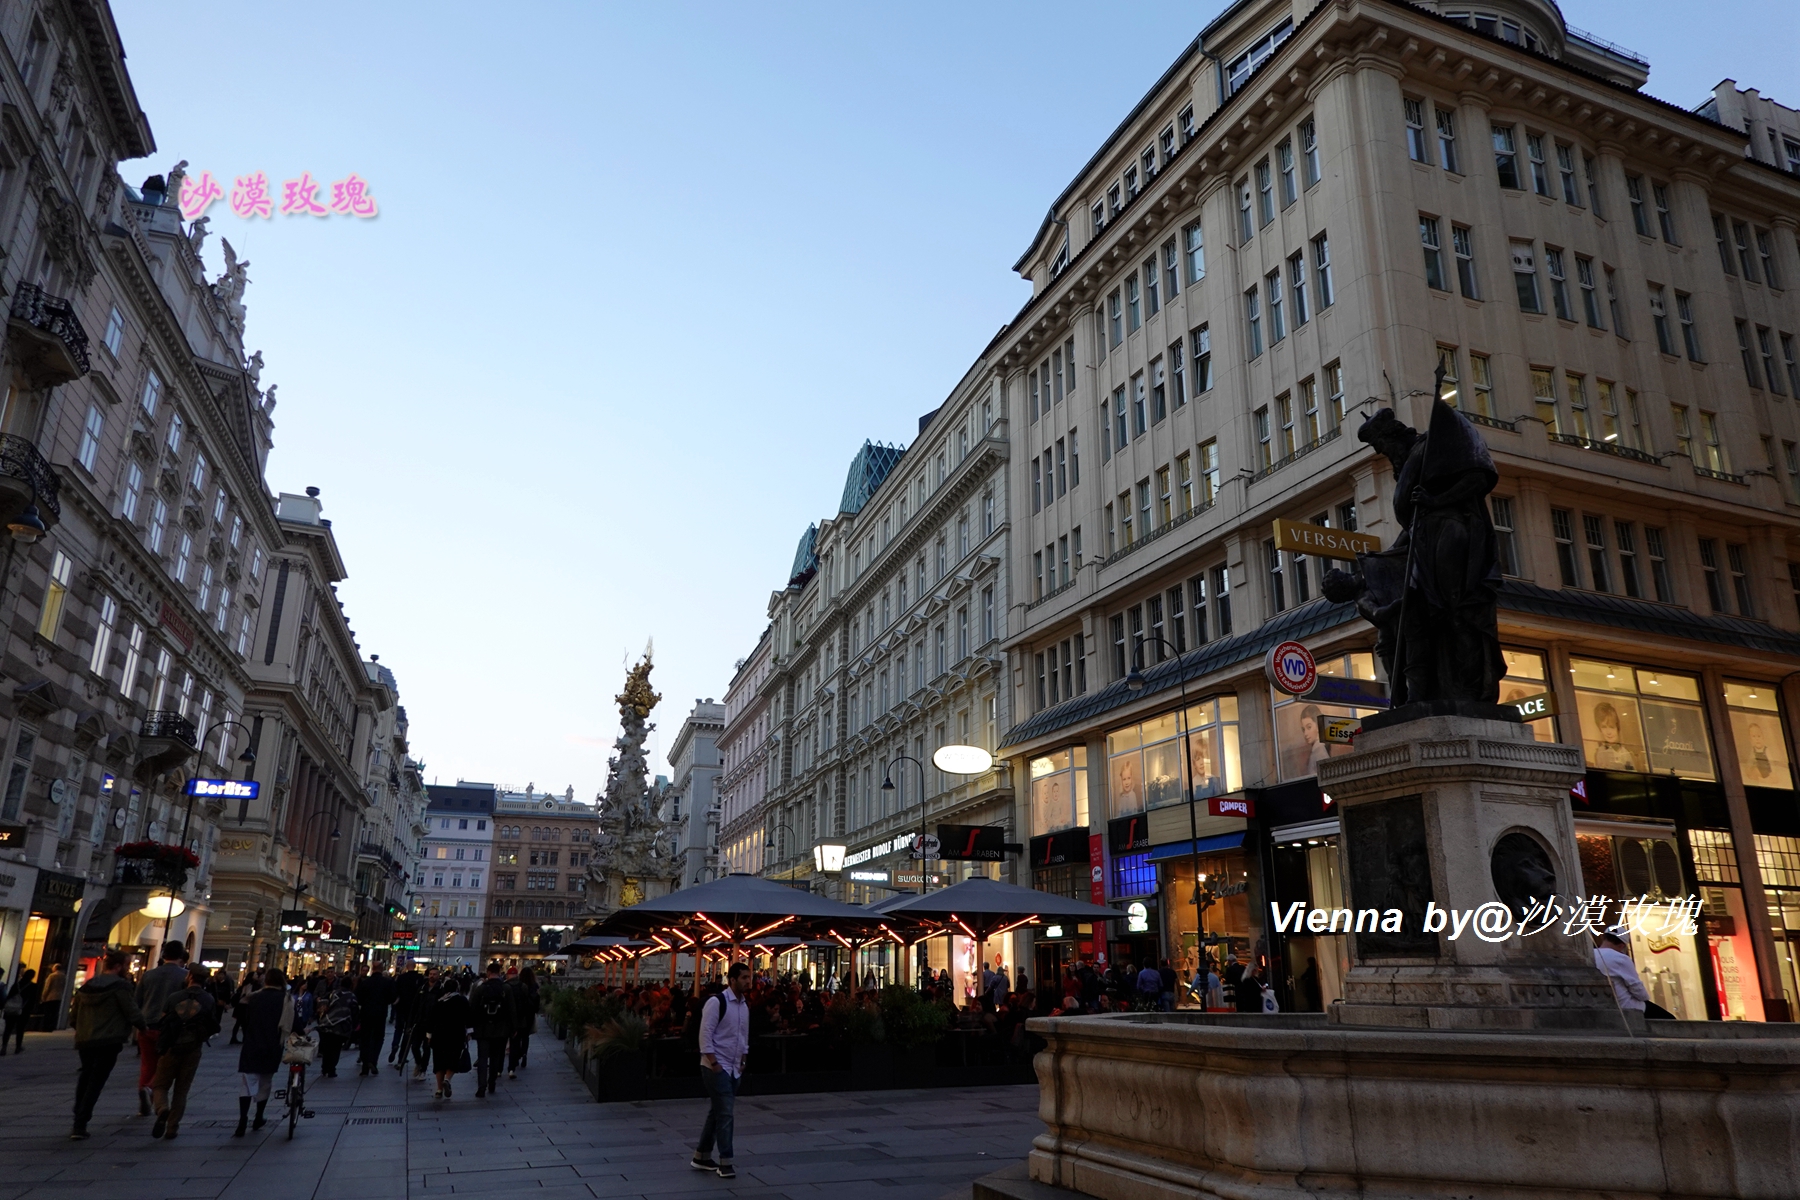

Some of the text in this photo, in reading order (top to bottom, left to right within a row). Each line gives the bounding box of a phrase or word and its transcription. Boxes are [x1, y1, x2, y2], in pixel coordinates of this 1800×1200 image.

[1290, 528, 1371, 554] VERSACE
[1329, 726, 1356, 739] Eissa
[195, 780, 252, 796] Berlitz
[1219, 800, 1248, 815] CAMPER
[872, 840, 892, 859] RUDOLF
[915, 836, 938, 850] Seafredo
[1132, 838, 1148, 849] GRABE
[947, 848, 960, 857] AM
[971, 849, 1000, 858] GRABEN
[897, 874, 932, 884] swatch
[47, 879, 77, 898] KNIZE
[1721, 956, 1735, 964] OLIS
[1722, 966, 1739, 974] OURS
[1724, 975, 1742, 983] ACADI
